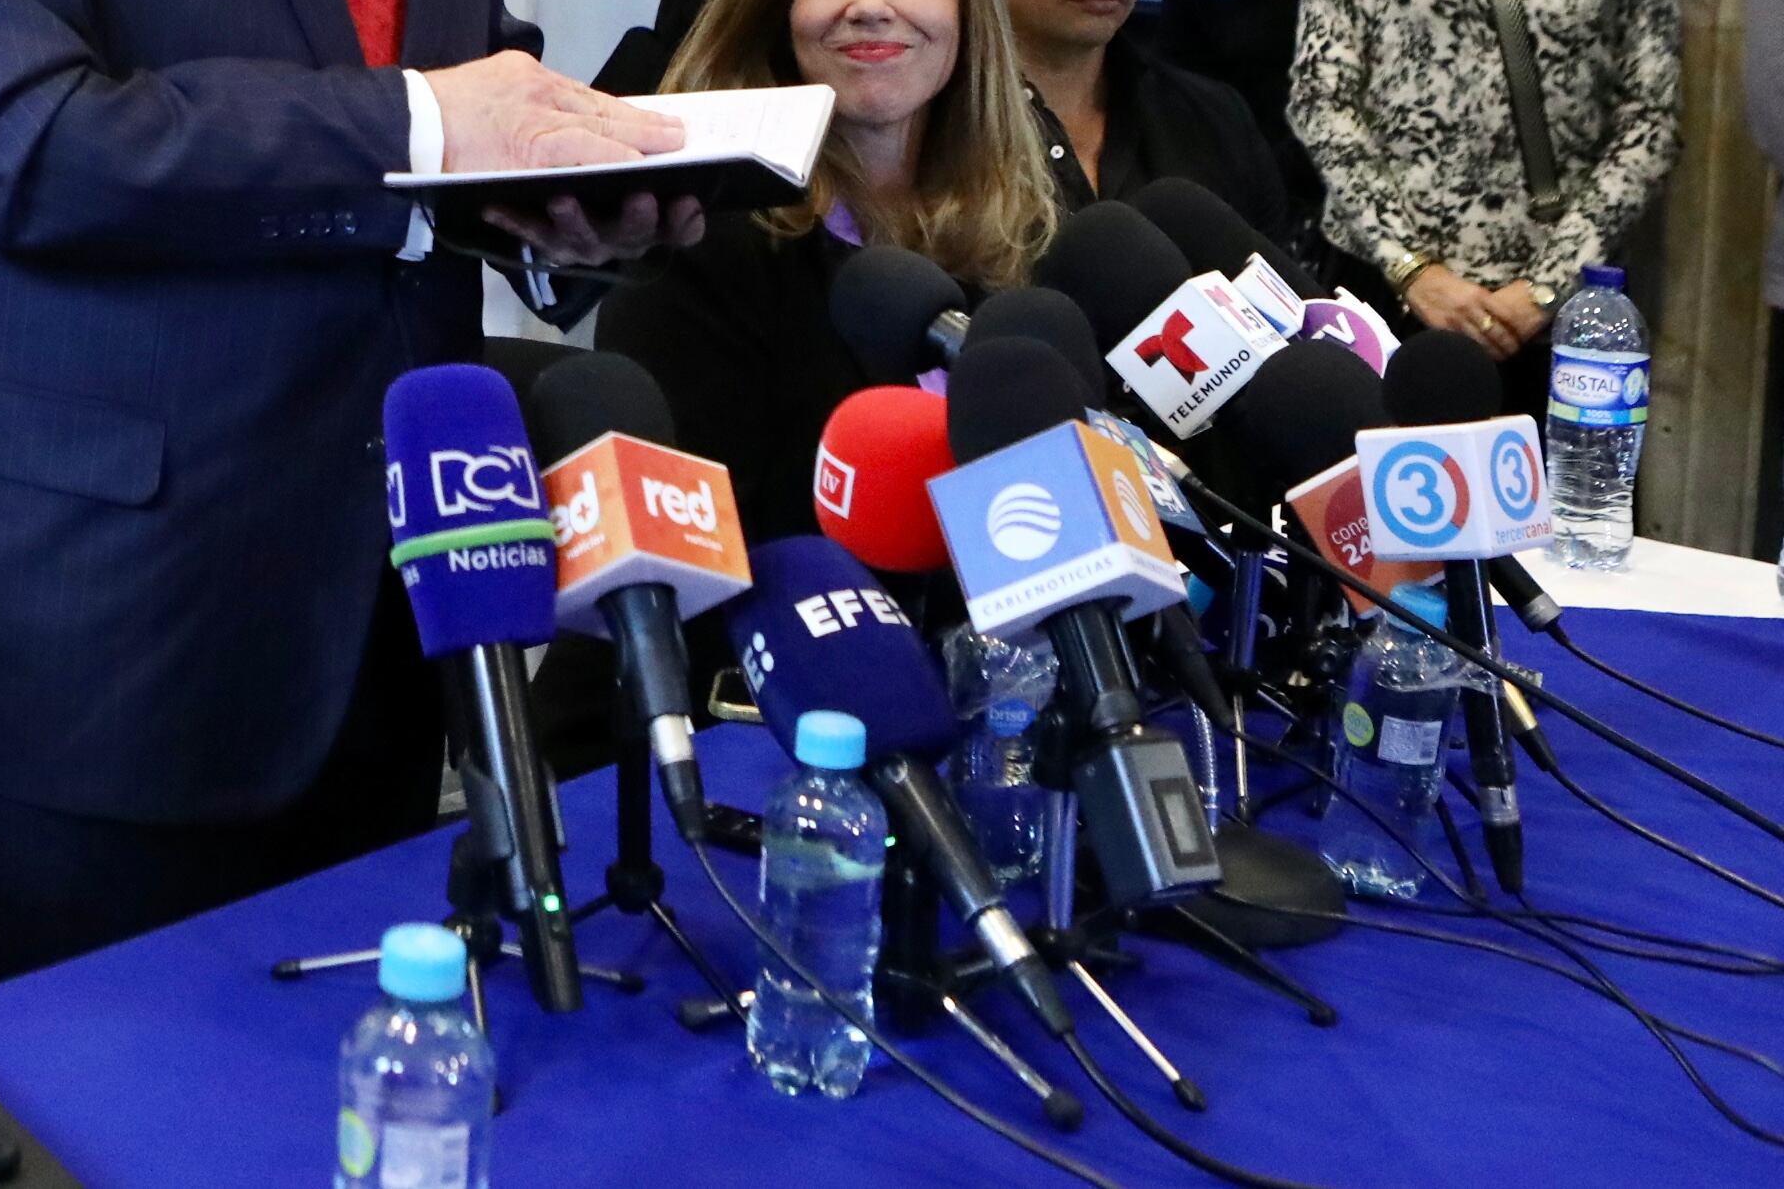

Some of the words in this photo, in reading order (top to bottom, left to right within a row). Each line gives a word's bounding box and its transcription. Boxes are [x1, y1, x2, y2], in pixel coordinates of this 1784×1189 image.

[1168, 348, 1252, 426] TELEMUNDO
[1556, 370, 1619, 393] CRISTAL
[1398, 461, 1445, 526] 3
[1502, 448, 1528, 502] 3
[550, 470, 600, 548] ed
[641, 475, 717, 533] red
[1330, 515, 1368, 546] cone
[447, 542, 548, 573] Noticias
